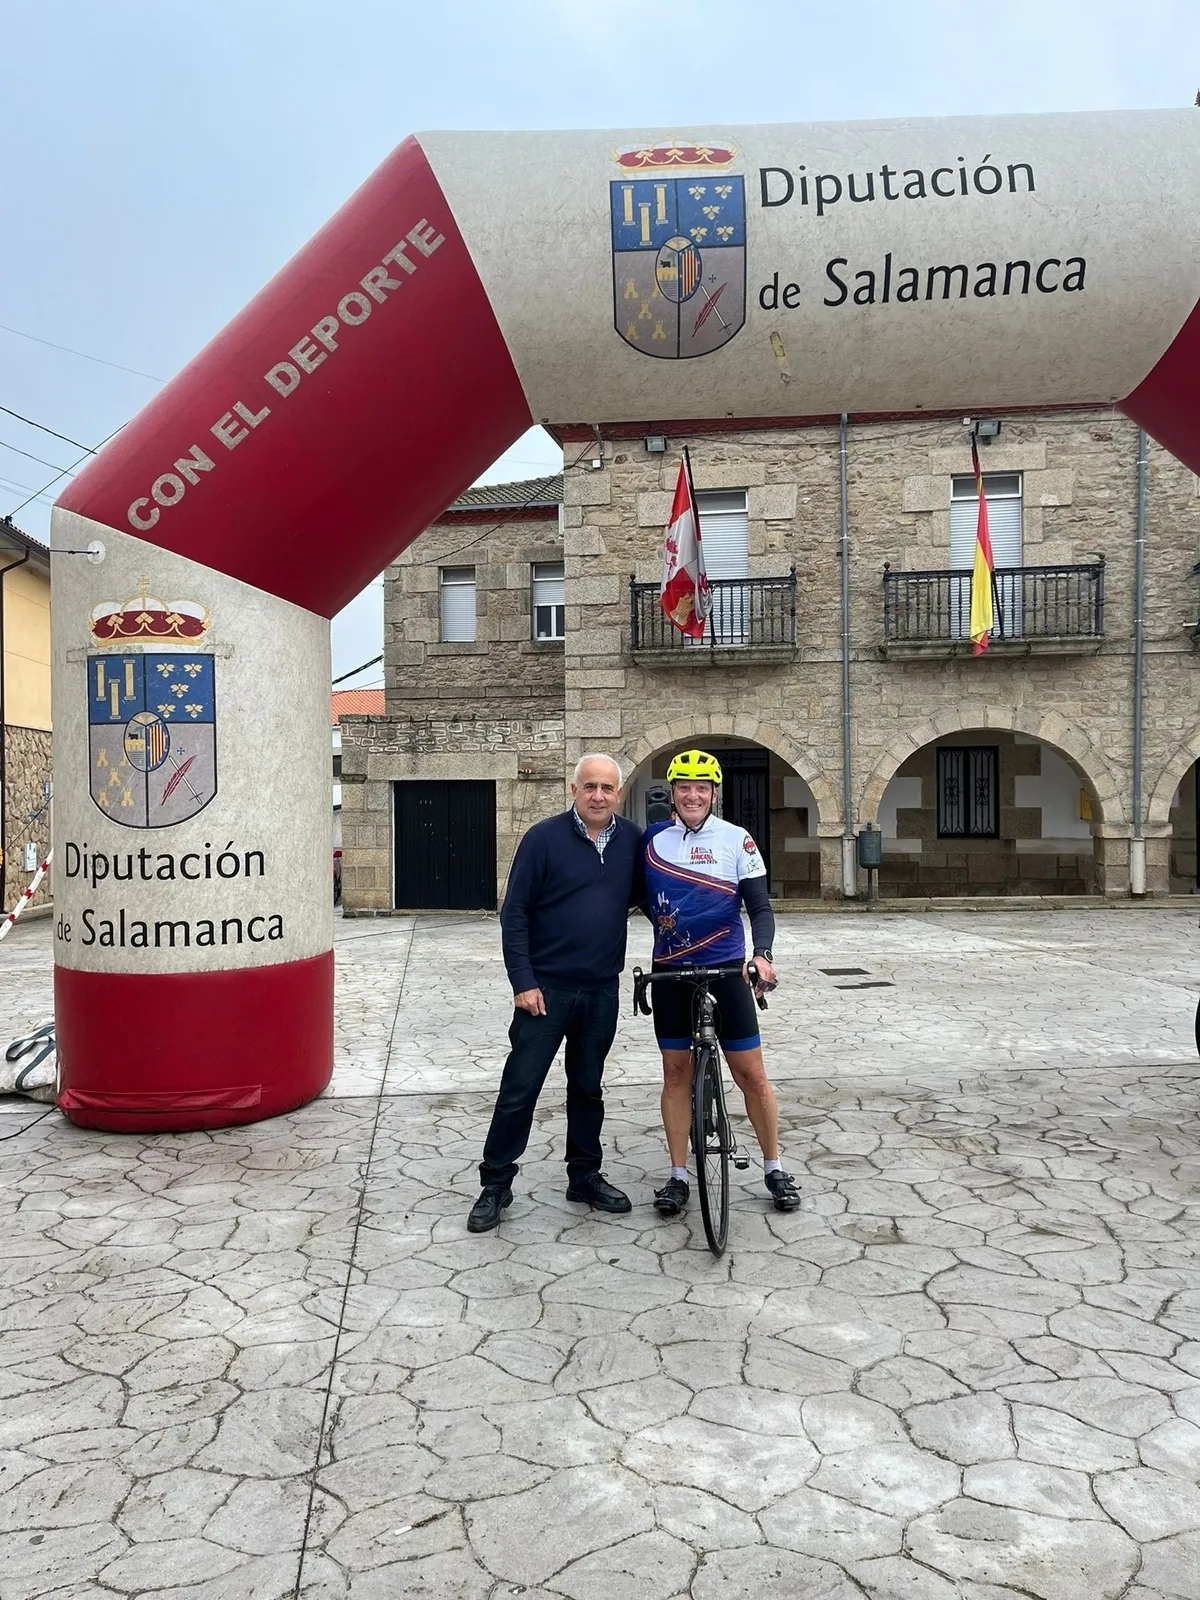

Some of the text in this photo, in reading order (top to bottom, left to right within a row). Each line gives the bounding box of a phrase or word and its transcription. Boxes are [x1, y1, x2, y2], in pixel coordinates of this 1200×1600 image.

[759, 153, 1036, 216] Diputación
[759, 252, 1087, 310] de Salamanca
[127, 218, 446, 530] CON EL DEPORTE
[65, 840, 265, 889] Diputación
[690, 846, 699, 854] LA
[57, 908, 284, 948] de Salamanca
